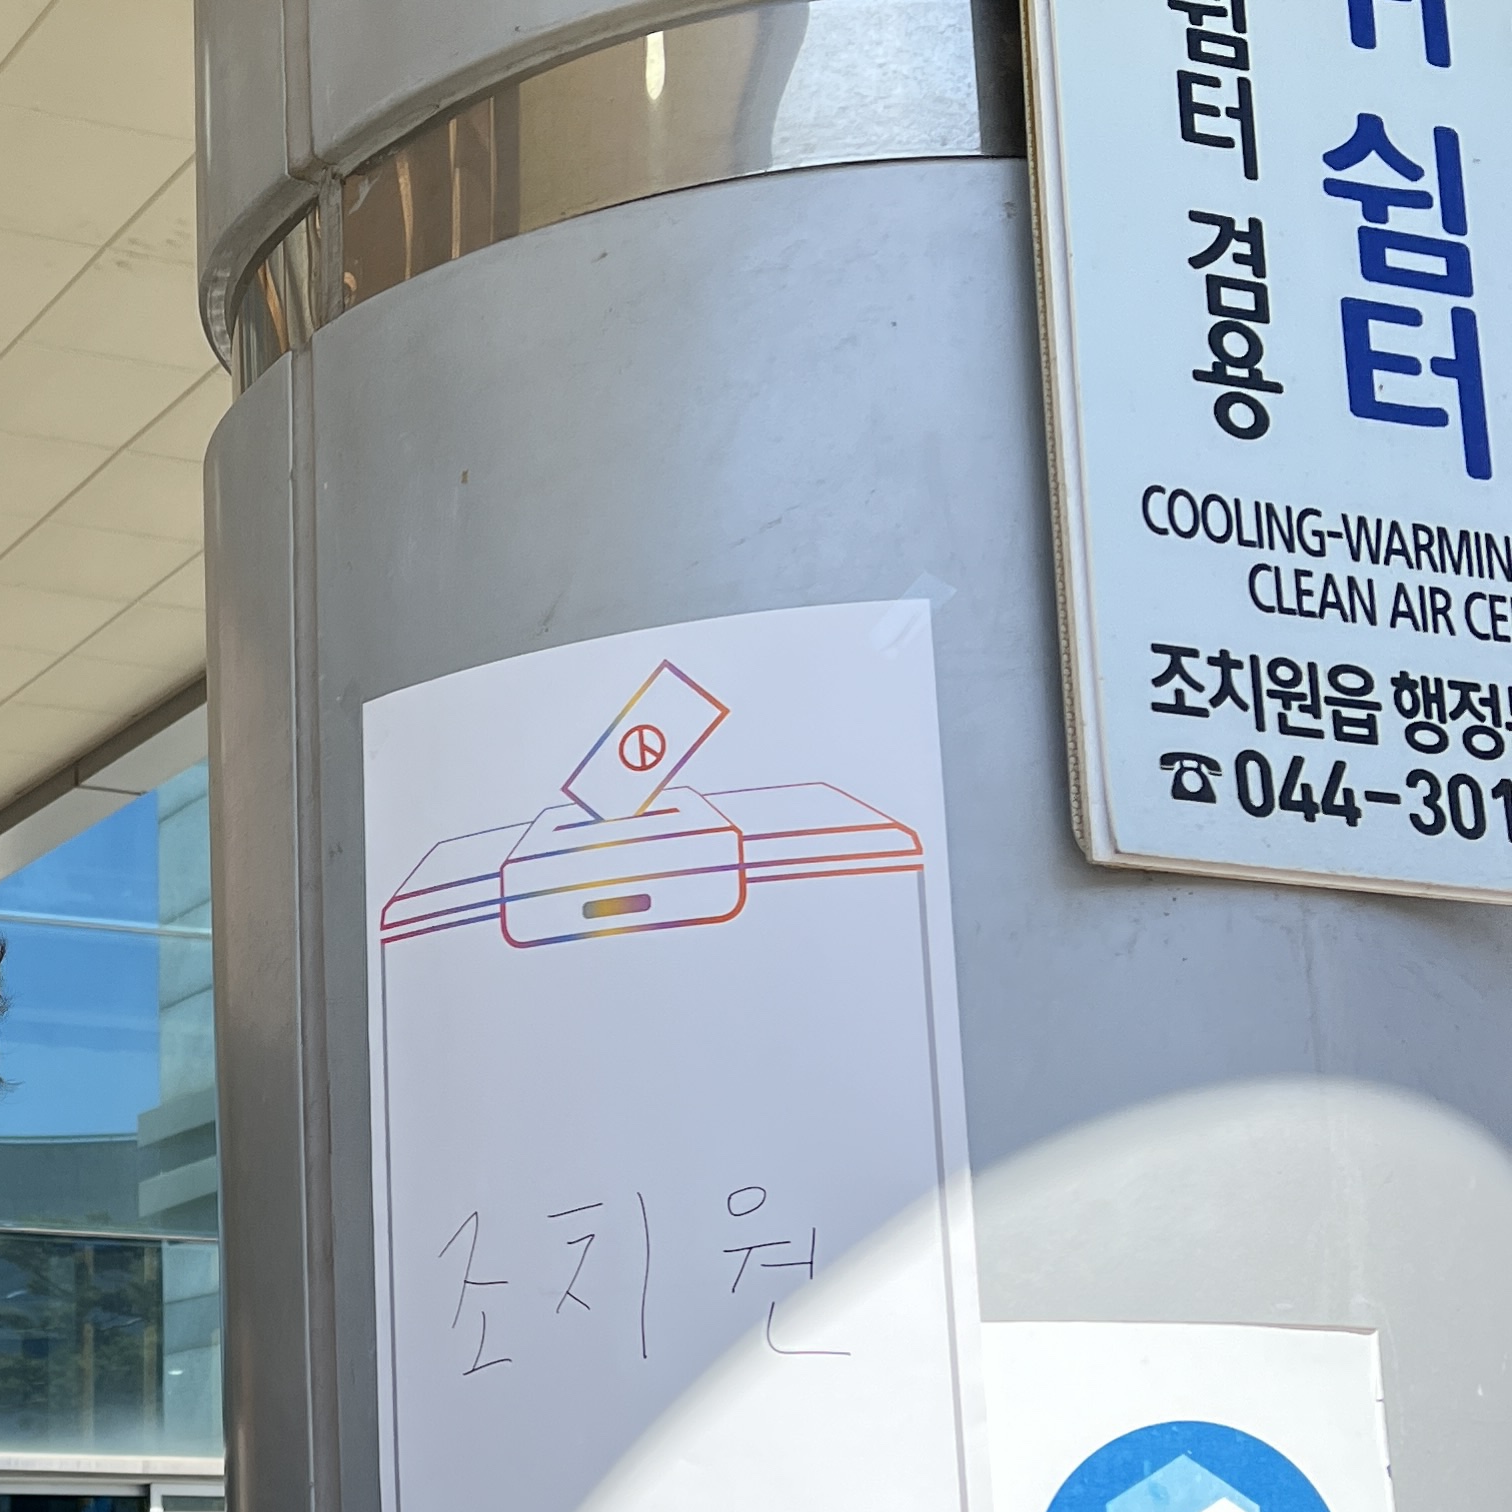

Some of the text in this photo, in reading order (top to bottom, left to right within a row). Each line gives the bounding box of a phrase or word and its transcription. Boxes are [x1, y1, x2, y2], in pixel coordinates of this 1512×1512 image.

[1188, 210, 1285, 440] 겸용
[1322, 113, 1492, 480] 쉼터
[1249, 563, 1512, 643] CLEAN AIR CE
[1151, 643, 1512, 761] 조치원읍 행정
